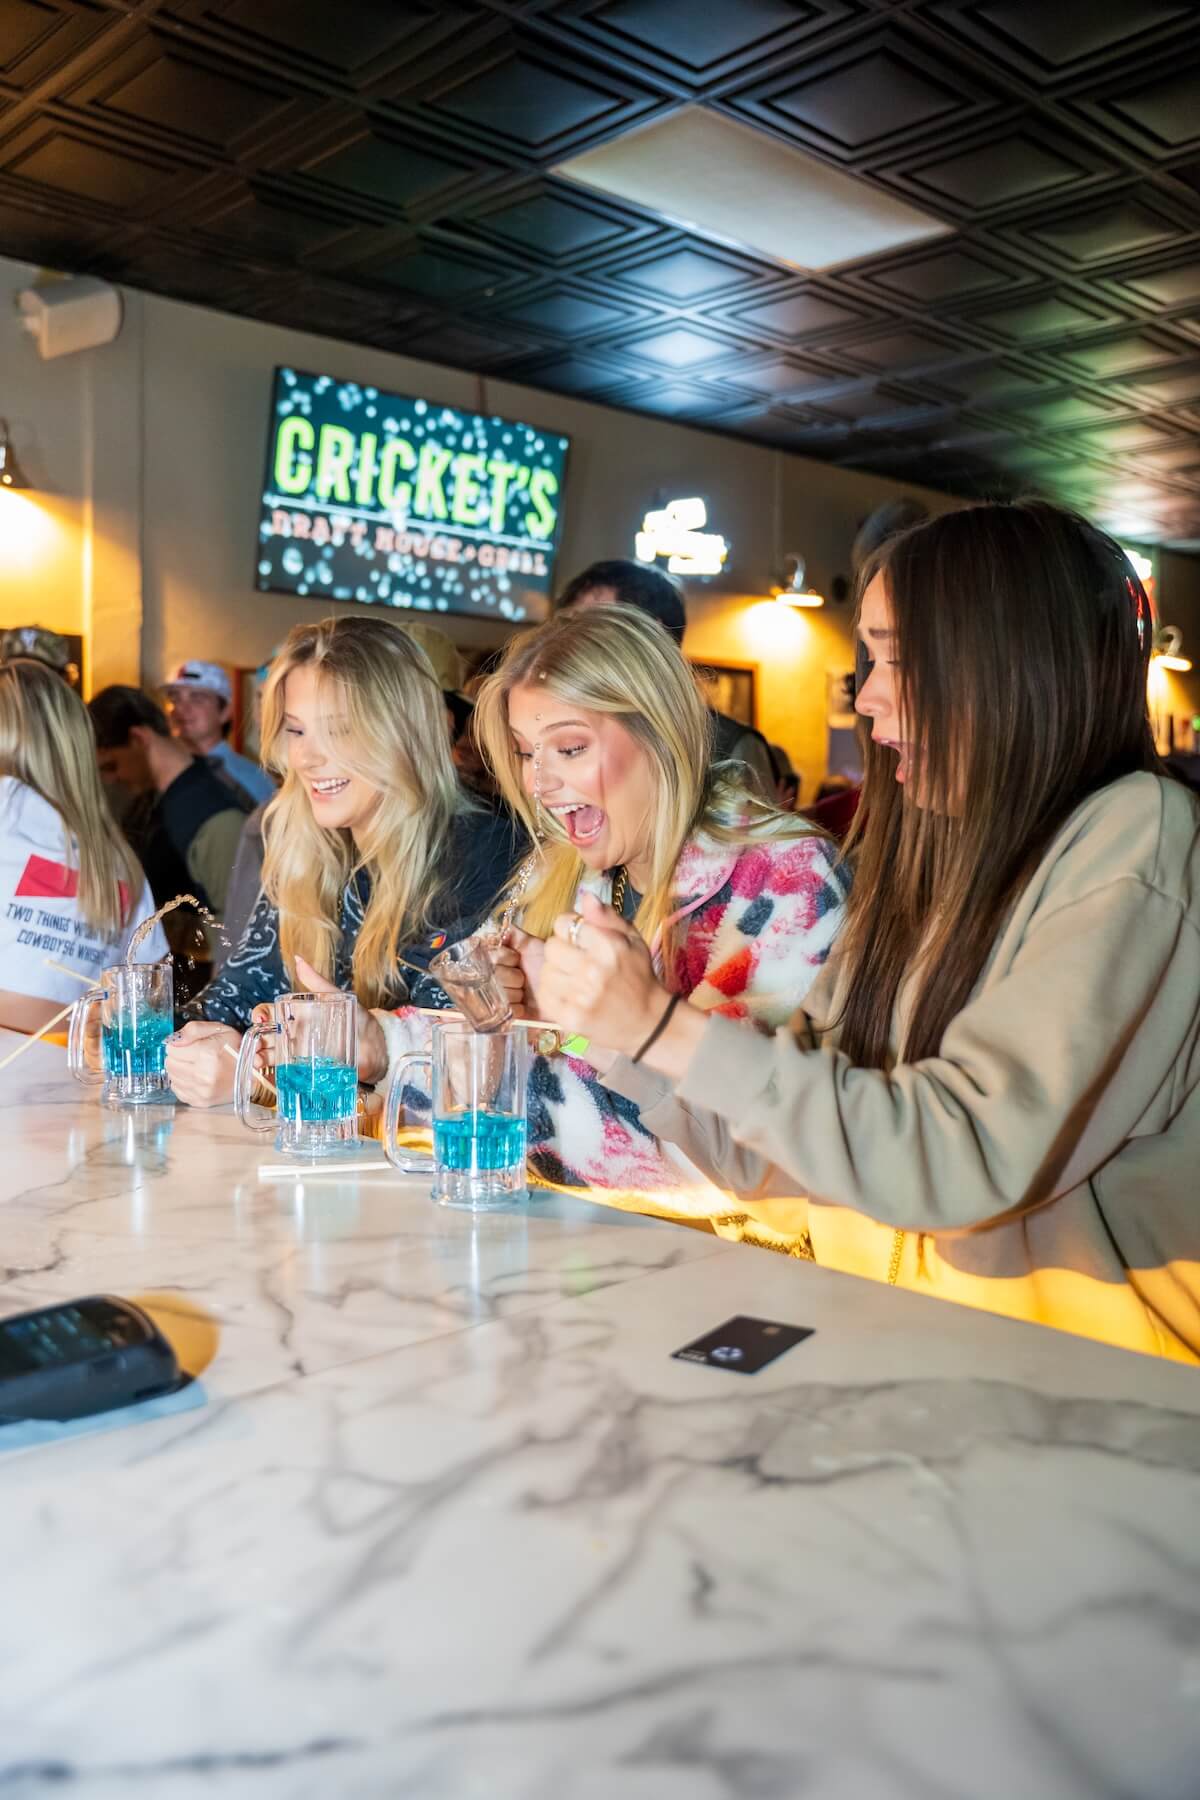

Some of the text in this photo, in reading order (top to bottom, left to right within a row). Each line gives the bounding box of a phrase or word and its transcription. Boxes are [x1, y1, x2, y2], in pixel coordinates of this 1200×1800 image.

[274, 415, 559, 541] CRICKET'S
[5, 903, 33, 923] TWO
[36, 909, 72, 934] THINGS
